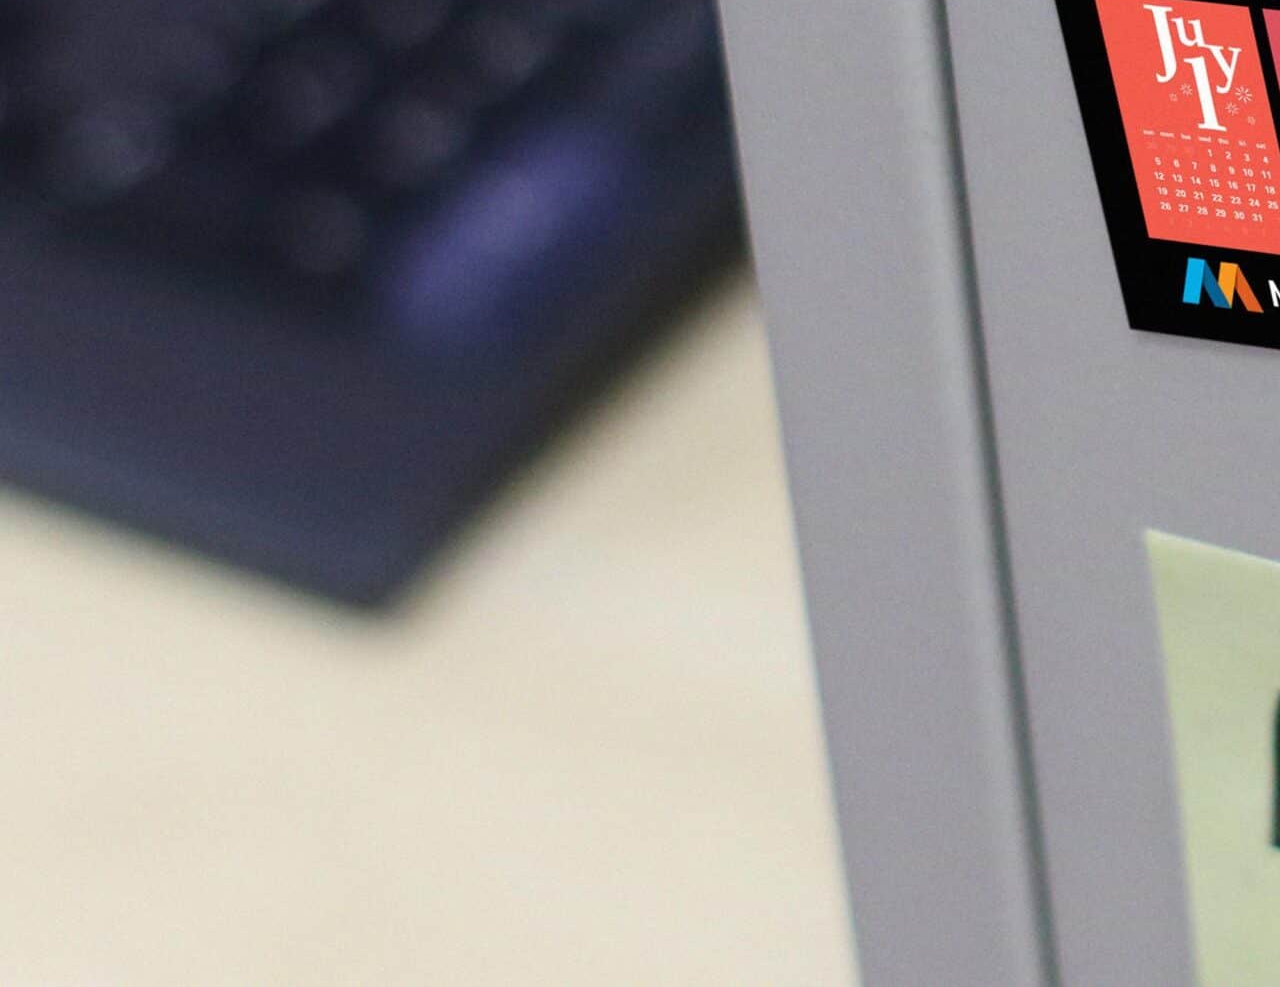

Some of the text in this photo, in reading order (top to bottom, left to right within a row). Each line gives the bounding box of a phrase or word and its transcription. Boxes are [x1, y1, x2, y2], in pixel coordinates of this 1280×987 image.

[1154, 156, 1272, 180] 5 6 7 8 9 10 11
[1207, 148, 1213, 158] 1
[1224, 150, 1232, 160] 2
[1243, 152, 1251, 162] 3
[1262, 156, 1269, 164] 4
[1153, 171, 1276, 195] 12 13 14 15 16 17 18
